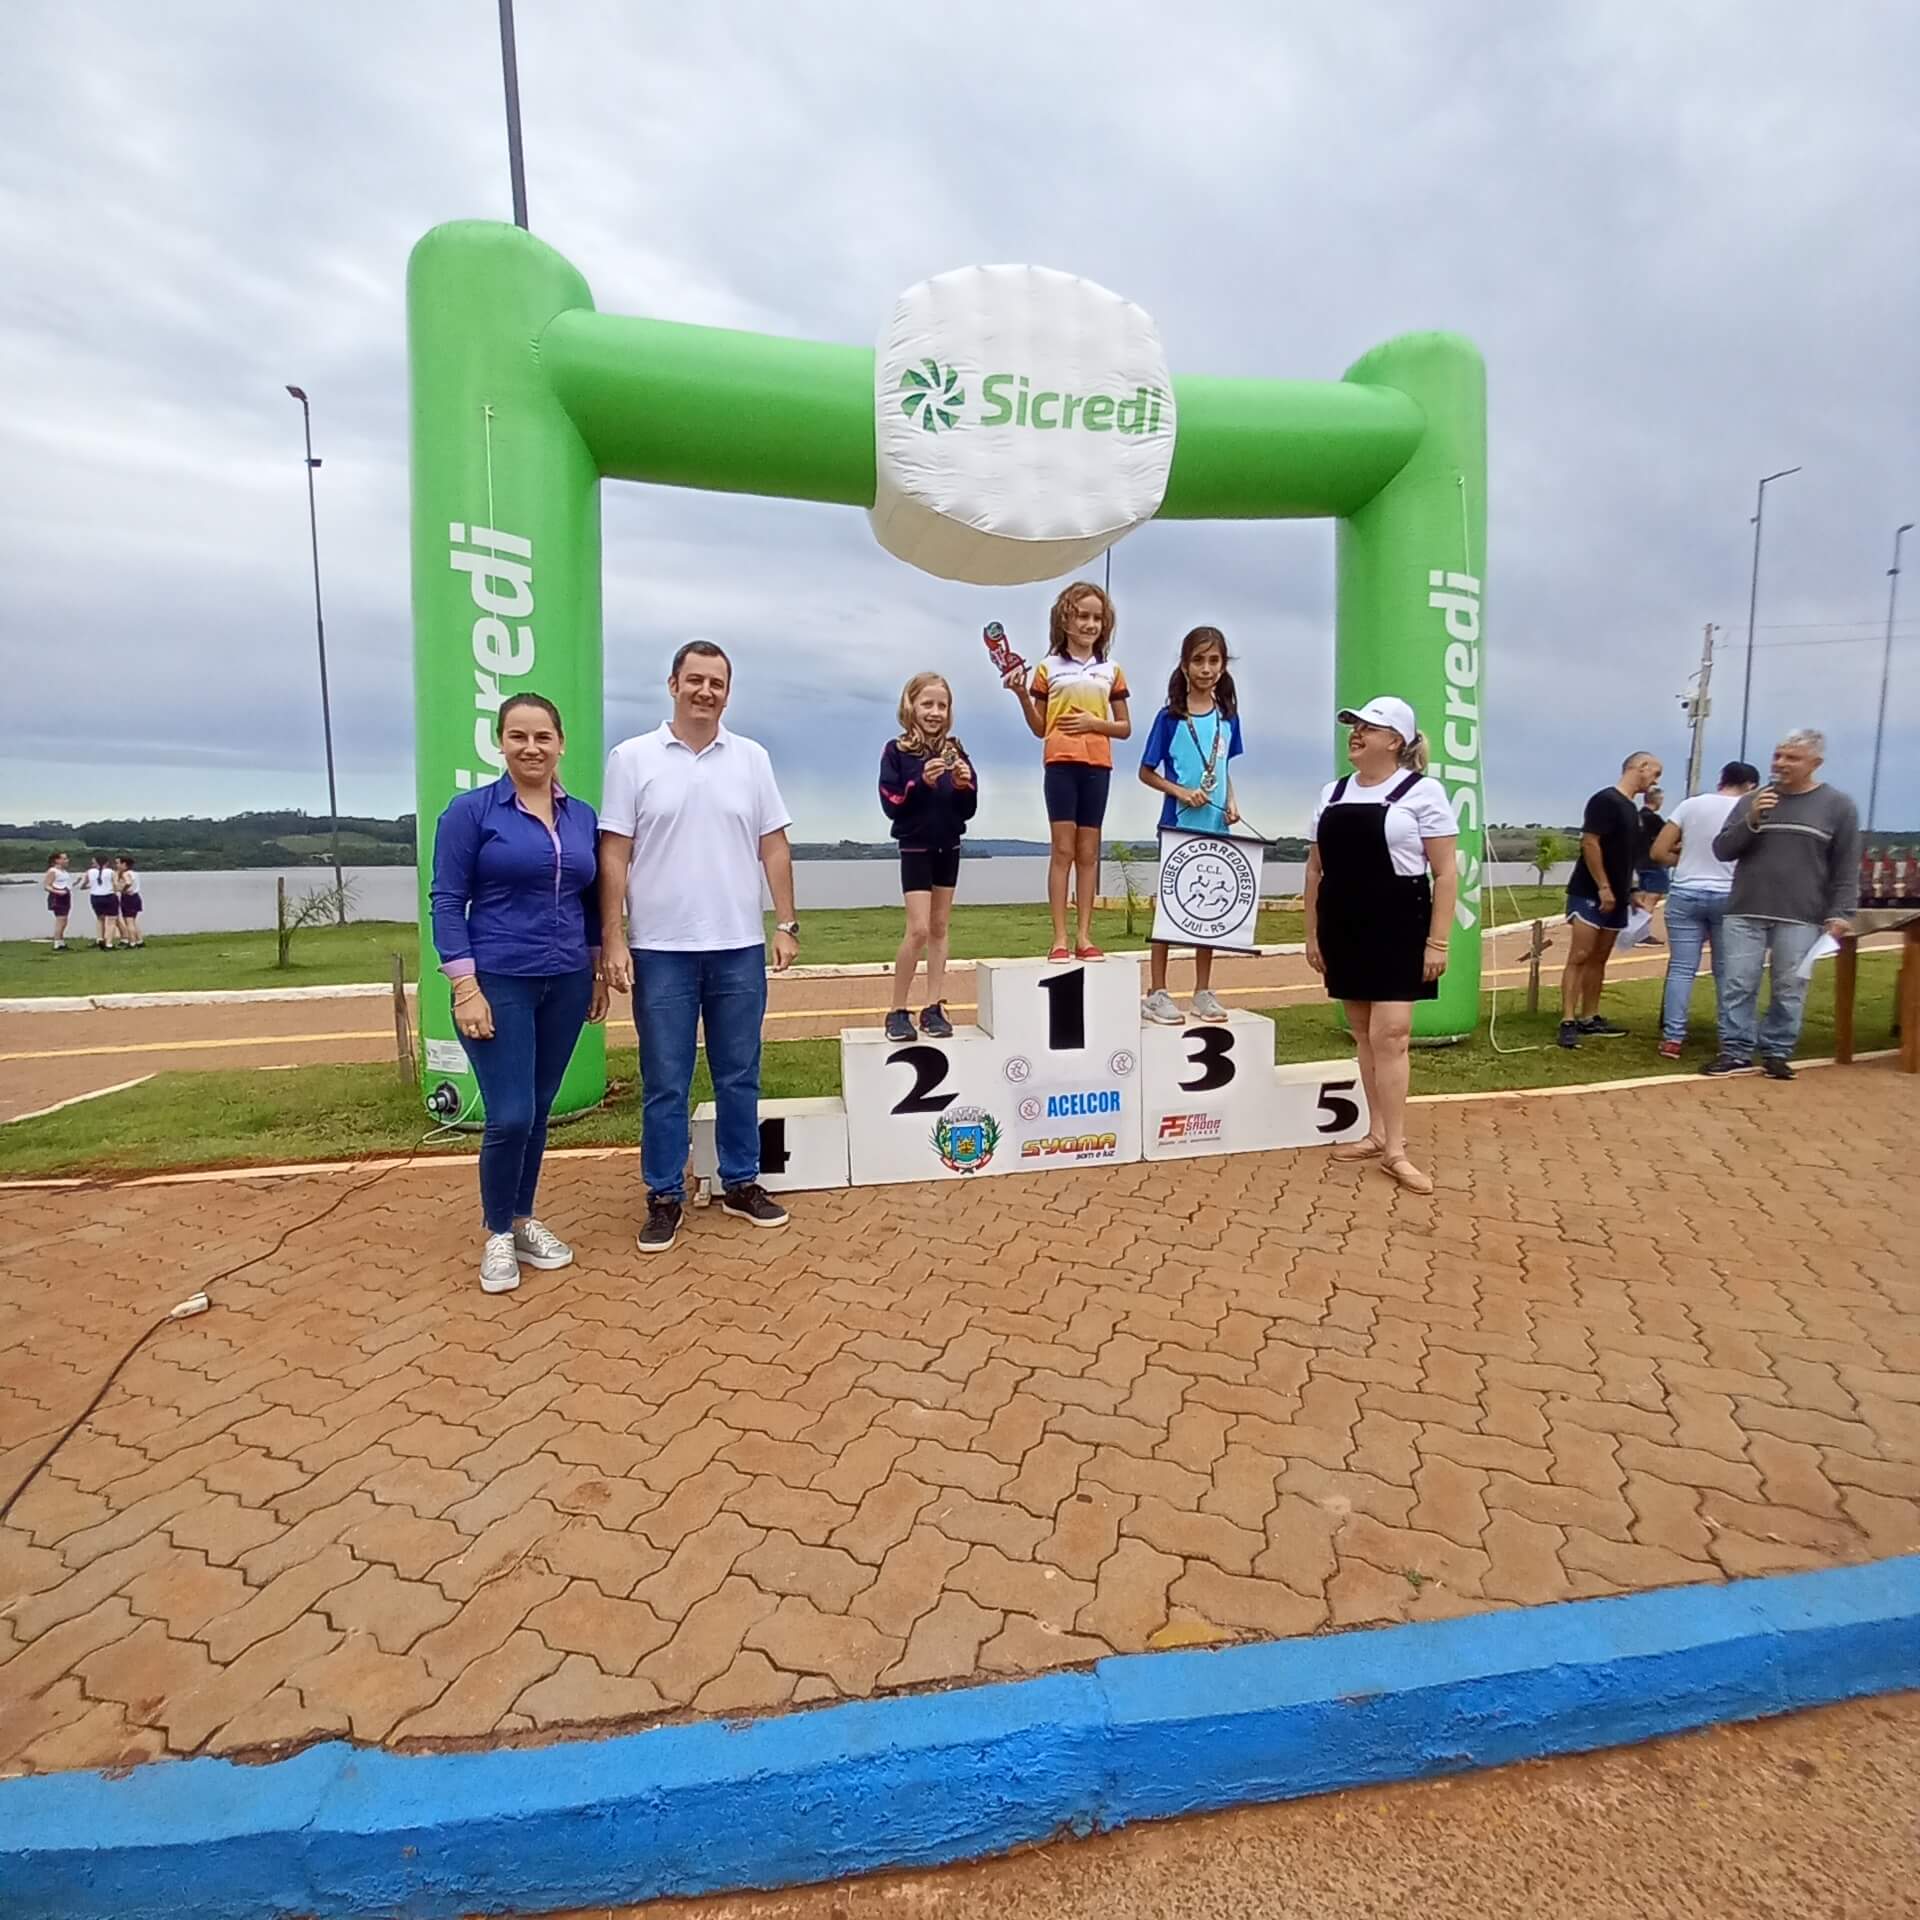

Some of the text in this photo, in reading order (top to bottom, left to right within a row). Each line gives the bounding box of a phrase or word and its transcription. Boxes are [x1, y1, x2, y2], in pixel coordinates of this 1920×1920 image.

[979, 373, 1161, 435] Sicredi
[1163, 842, 1252, 905] CLUBE DE CORREDORES DE
[1037, 966, 1086, 1050] 1
[885, 1045, 960, 1115] 2
[1177, 1026, 1236, 1092] 3
[1047, 1091, 1121, 1118] ACELCOR
[1316, 1080, 1359, 1134] 5
